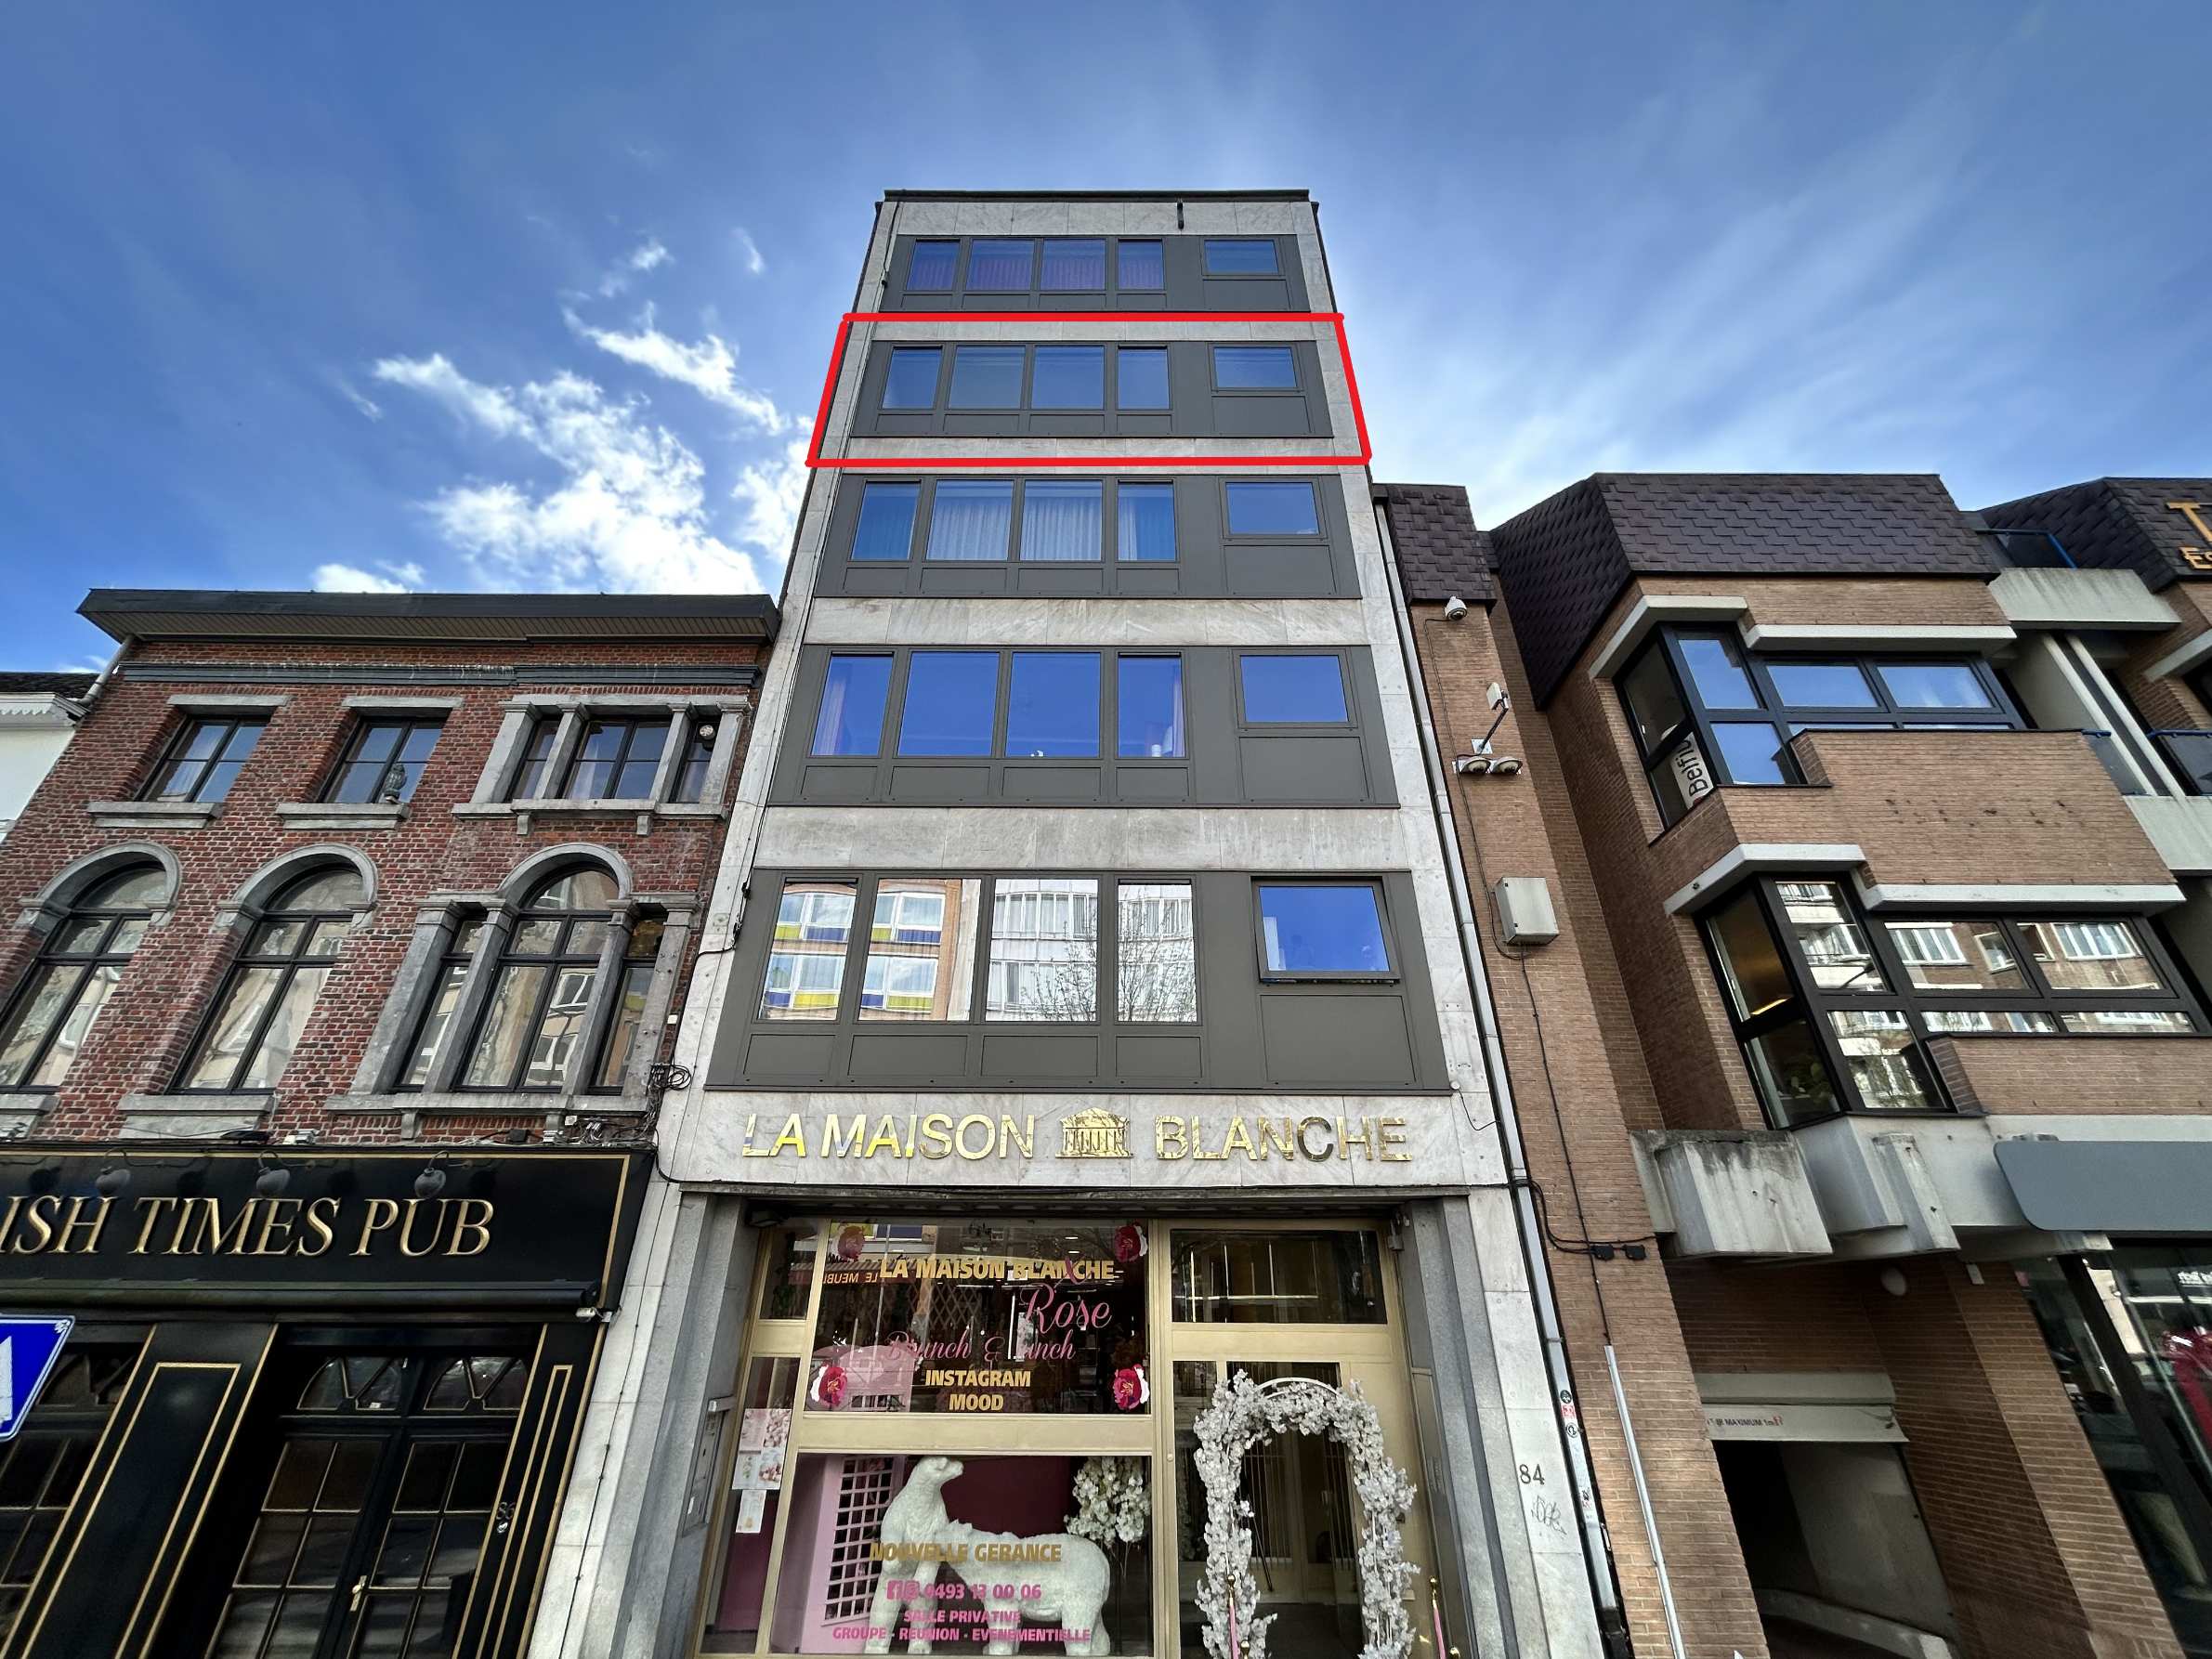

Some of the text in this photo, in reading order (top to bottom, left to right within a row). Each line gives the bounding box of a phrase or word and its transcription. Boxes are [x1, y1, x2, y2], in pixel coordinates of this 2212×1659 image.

[742, 1113, 1413, 1161] LA MAISON BLANCHE
[127, 1196, 341, 1255] TIMES
[349, 1198, 494, 1256] PUB
[880, 1259, 1115, 1280] LA MAISON BLANCHE
[1019, 1283, 1112, 1334] Rose
[924, 1369, 1031, 1388] INSTAGRAM
[949, 1393, 1004, 1412] MOOD
[1519, 1464, 1545, 1485] 84
[869, 1542, 1062, 1562] NOUVELLE GERANCE
[924, 1583, 965, 1600] 0493
[992, 1583, 1014, 1600] 00
[1020, 1583, 1041, 1600] 06
[903, 1609, 1021, 1624] SALLE PRIVATIVE
[831, 1626, 886, 1641] GROUPE
[898, 1627, 960, 1641] REUNION
